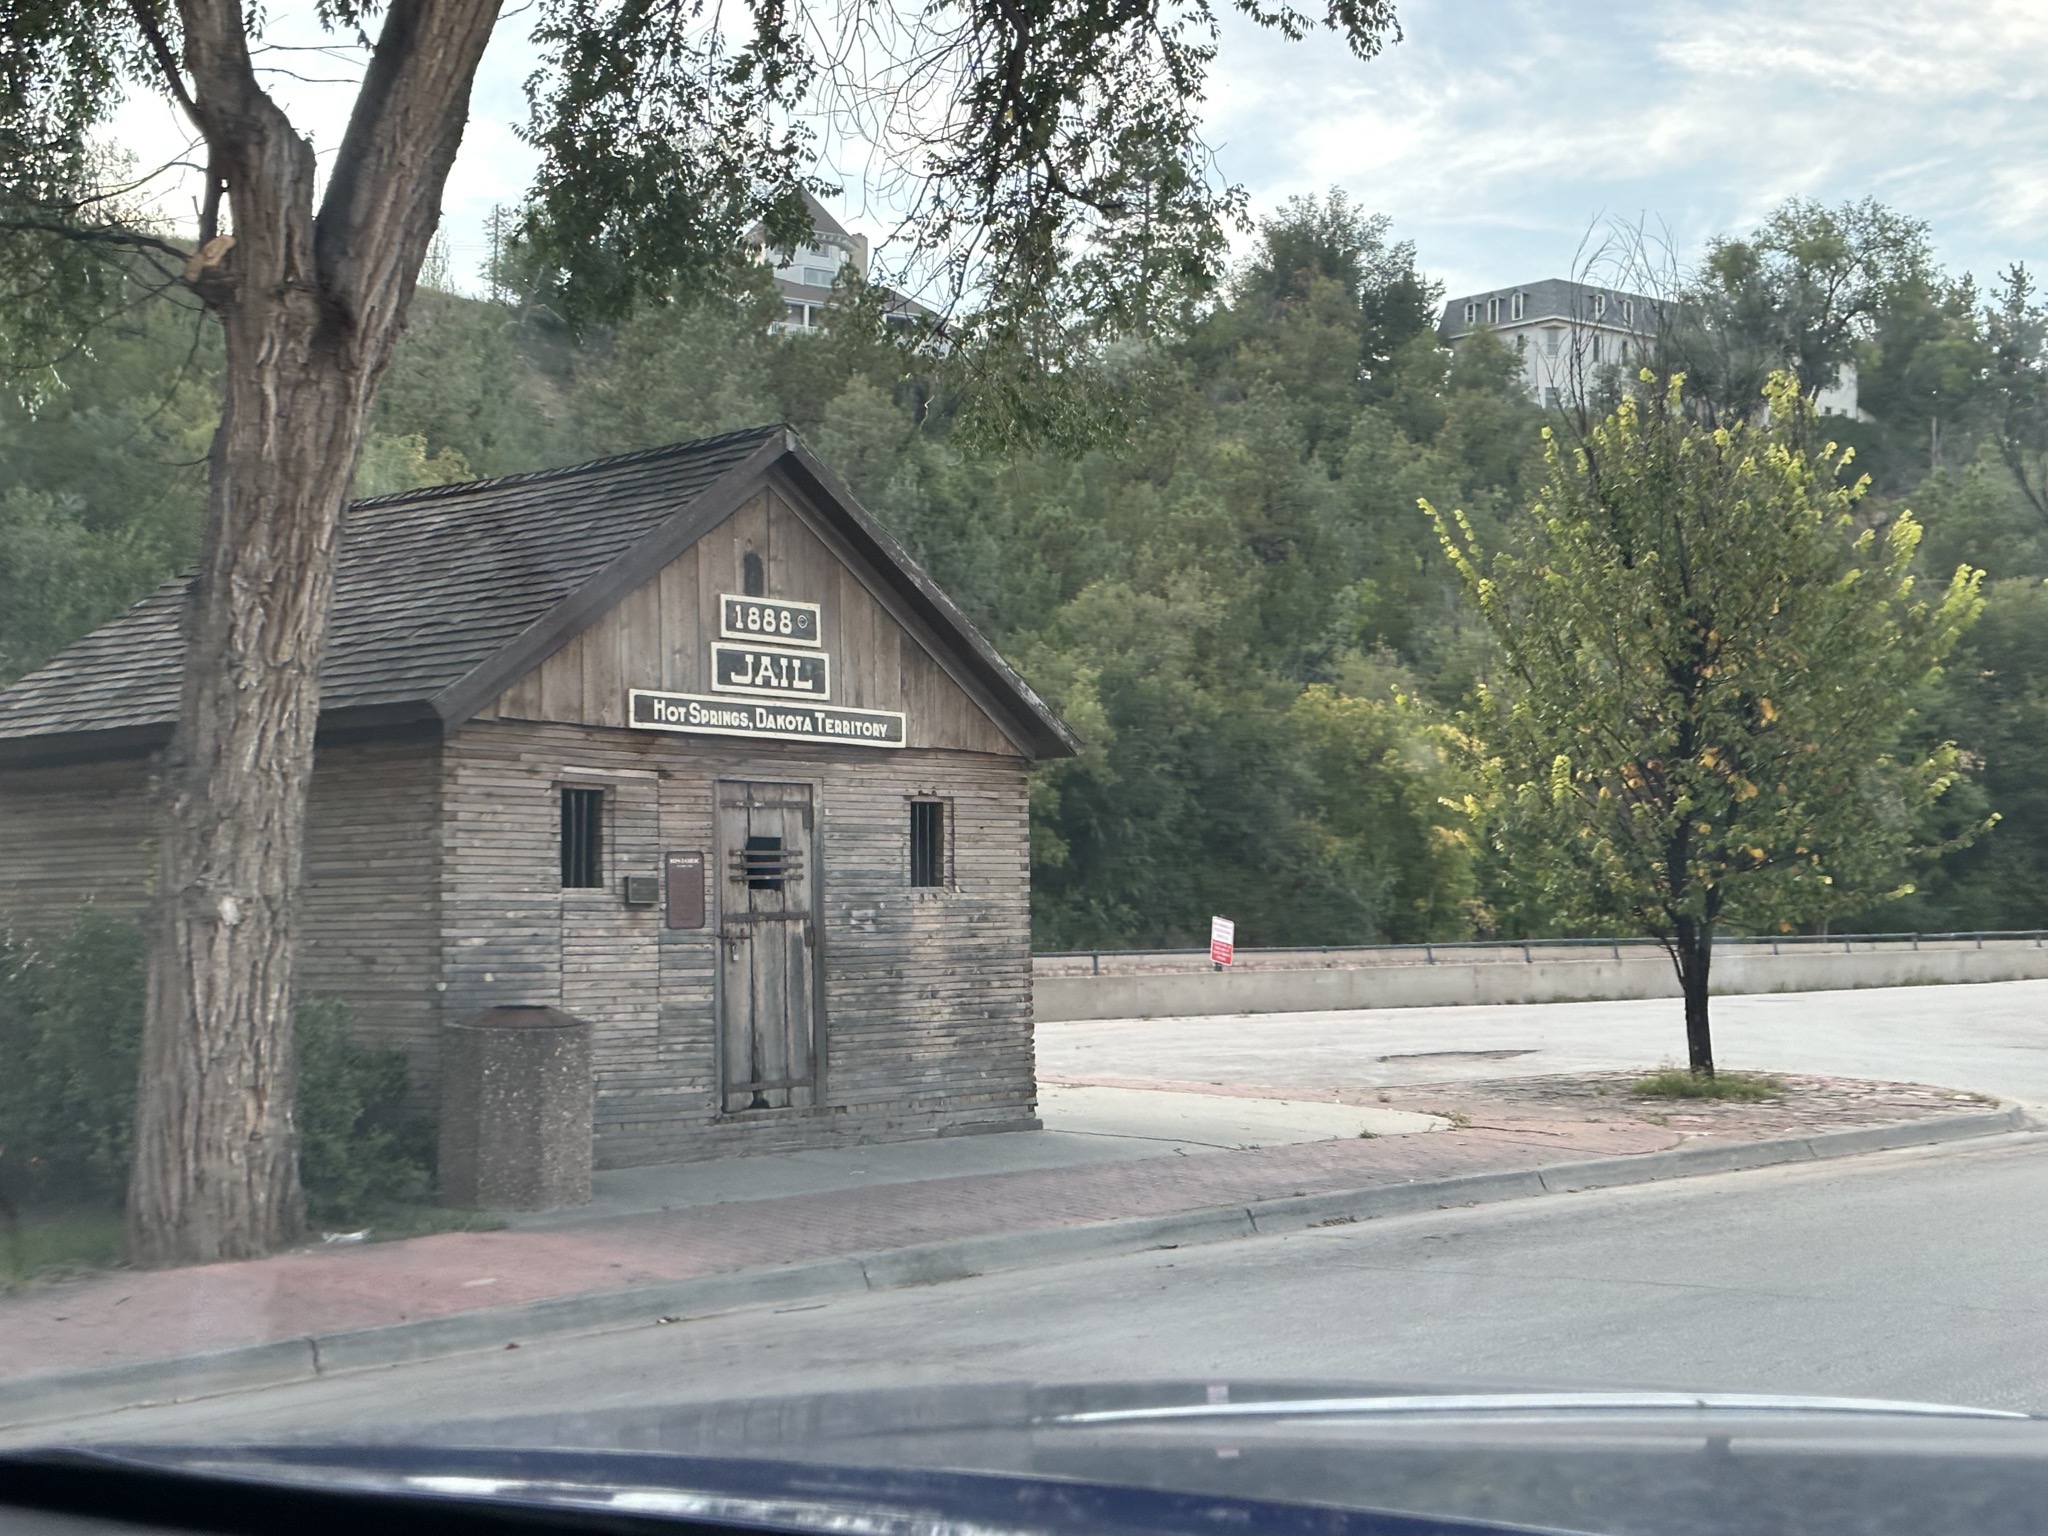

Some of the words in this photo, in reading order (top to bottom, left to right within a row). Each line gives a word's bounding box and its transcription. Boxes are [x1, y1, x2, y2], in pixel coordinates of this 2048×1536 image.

[735, 604, 792, 634] 1888
[730, 654, 813, 690] JAIL
[654, 699, 687, 722] HOT
[689, 702, 753, 731] SPRINGS,
[755, 707, 813, 732] DAKOTA
[815, 712, 888, 738] TERRITORY
